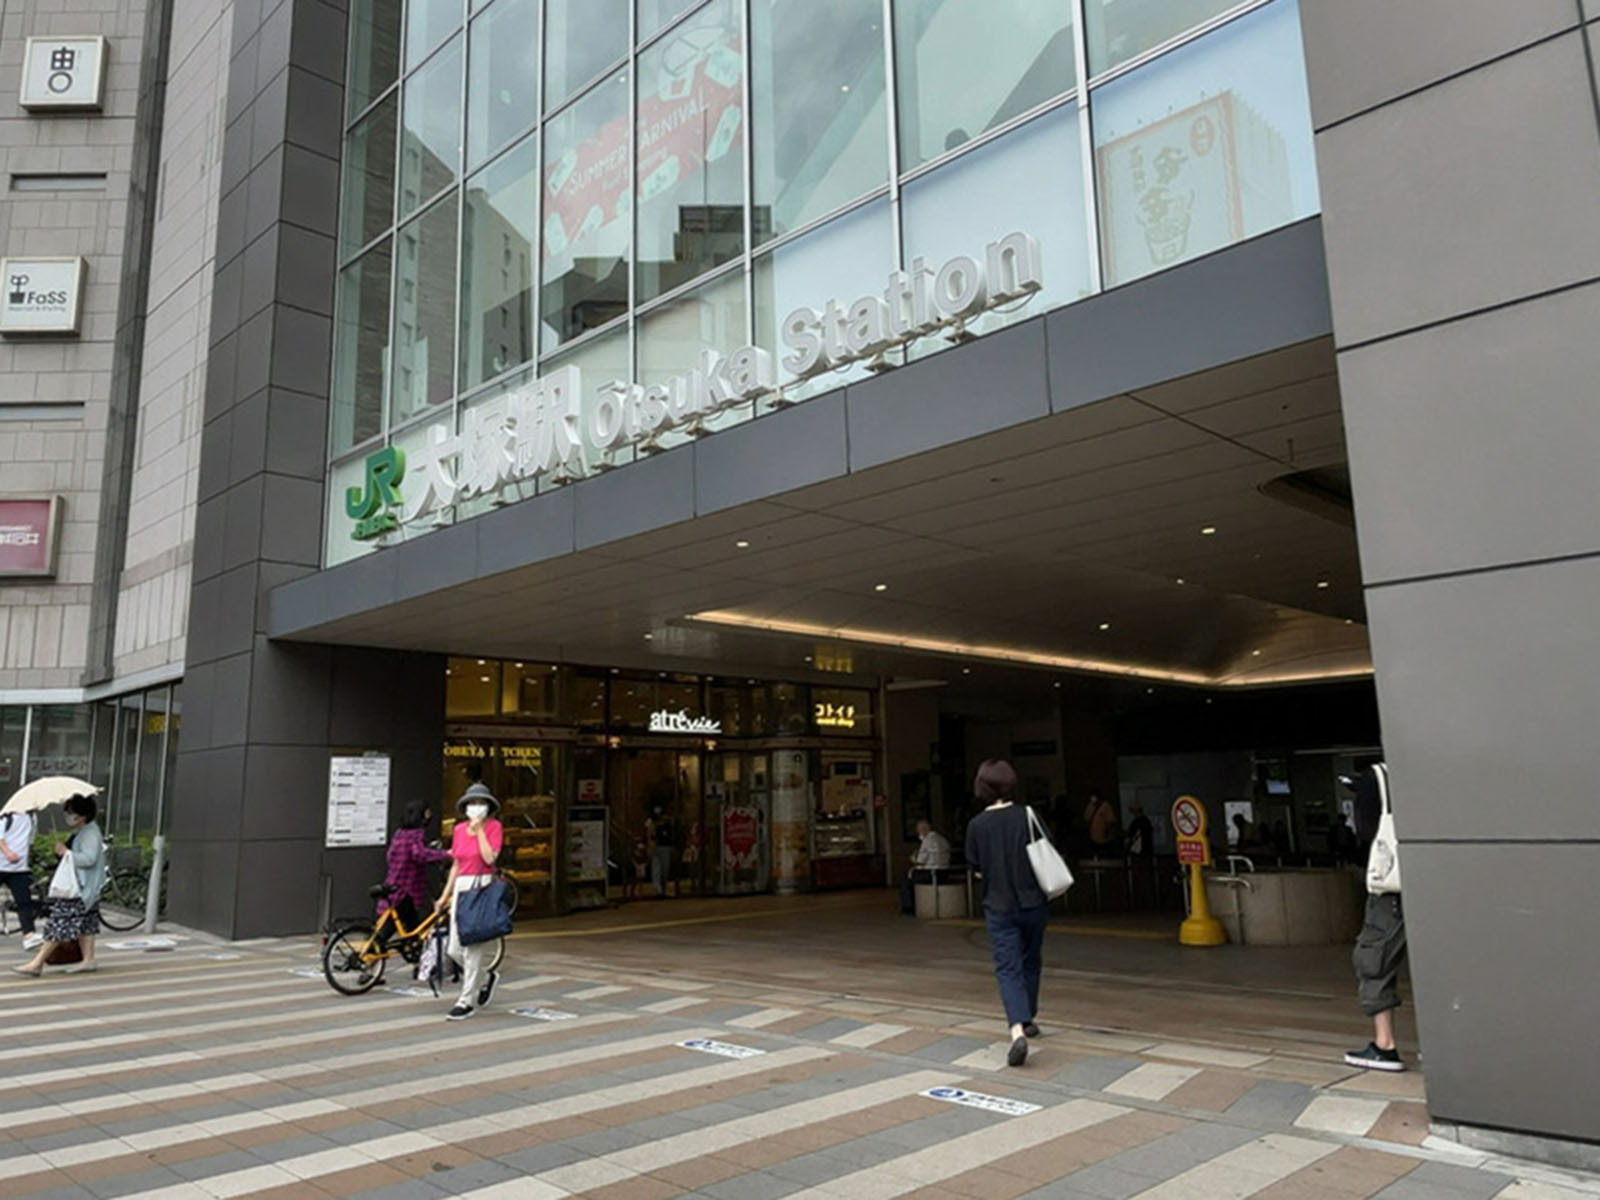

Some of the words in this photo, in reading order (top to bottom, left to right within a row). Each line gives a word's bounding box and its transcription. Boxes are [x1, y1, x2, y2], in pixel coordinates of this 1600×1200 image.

[634, 89, 709, 151] ARNIVAL
[782, 231, 1042, 376] Station
[345, 446, 406, 520] JR
[397, 364, 581, 522] 大塚駅
